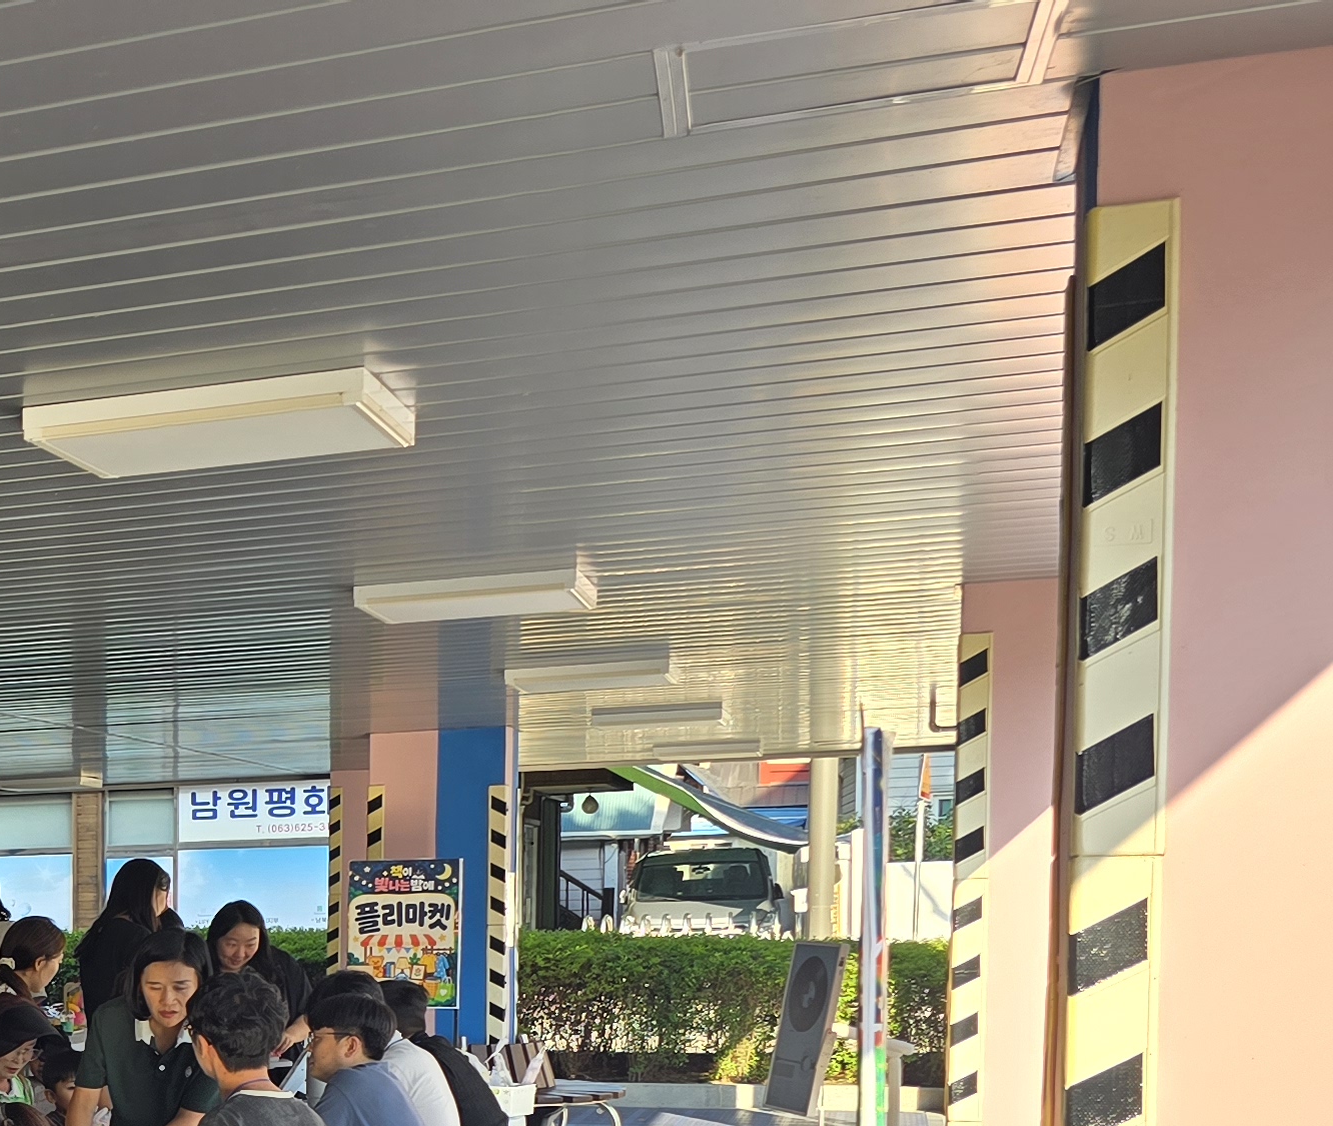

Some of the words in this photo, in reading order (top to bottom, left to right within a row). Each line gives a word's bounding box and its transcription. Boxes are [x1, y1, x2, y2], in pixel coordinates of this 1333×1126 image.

[268, 823, 329, 833] (063)625-3
[390, 865, 412, 878] 책이
[374, 877, 410, 892] 빛나는
[410, 879, 435, 892] 밤에
[354, 901, 452, 935] 플리마켓
